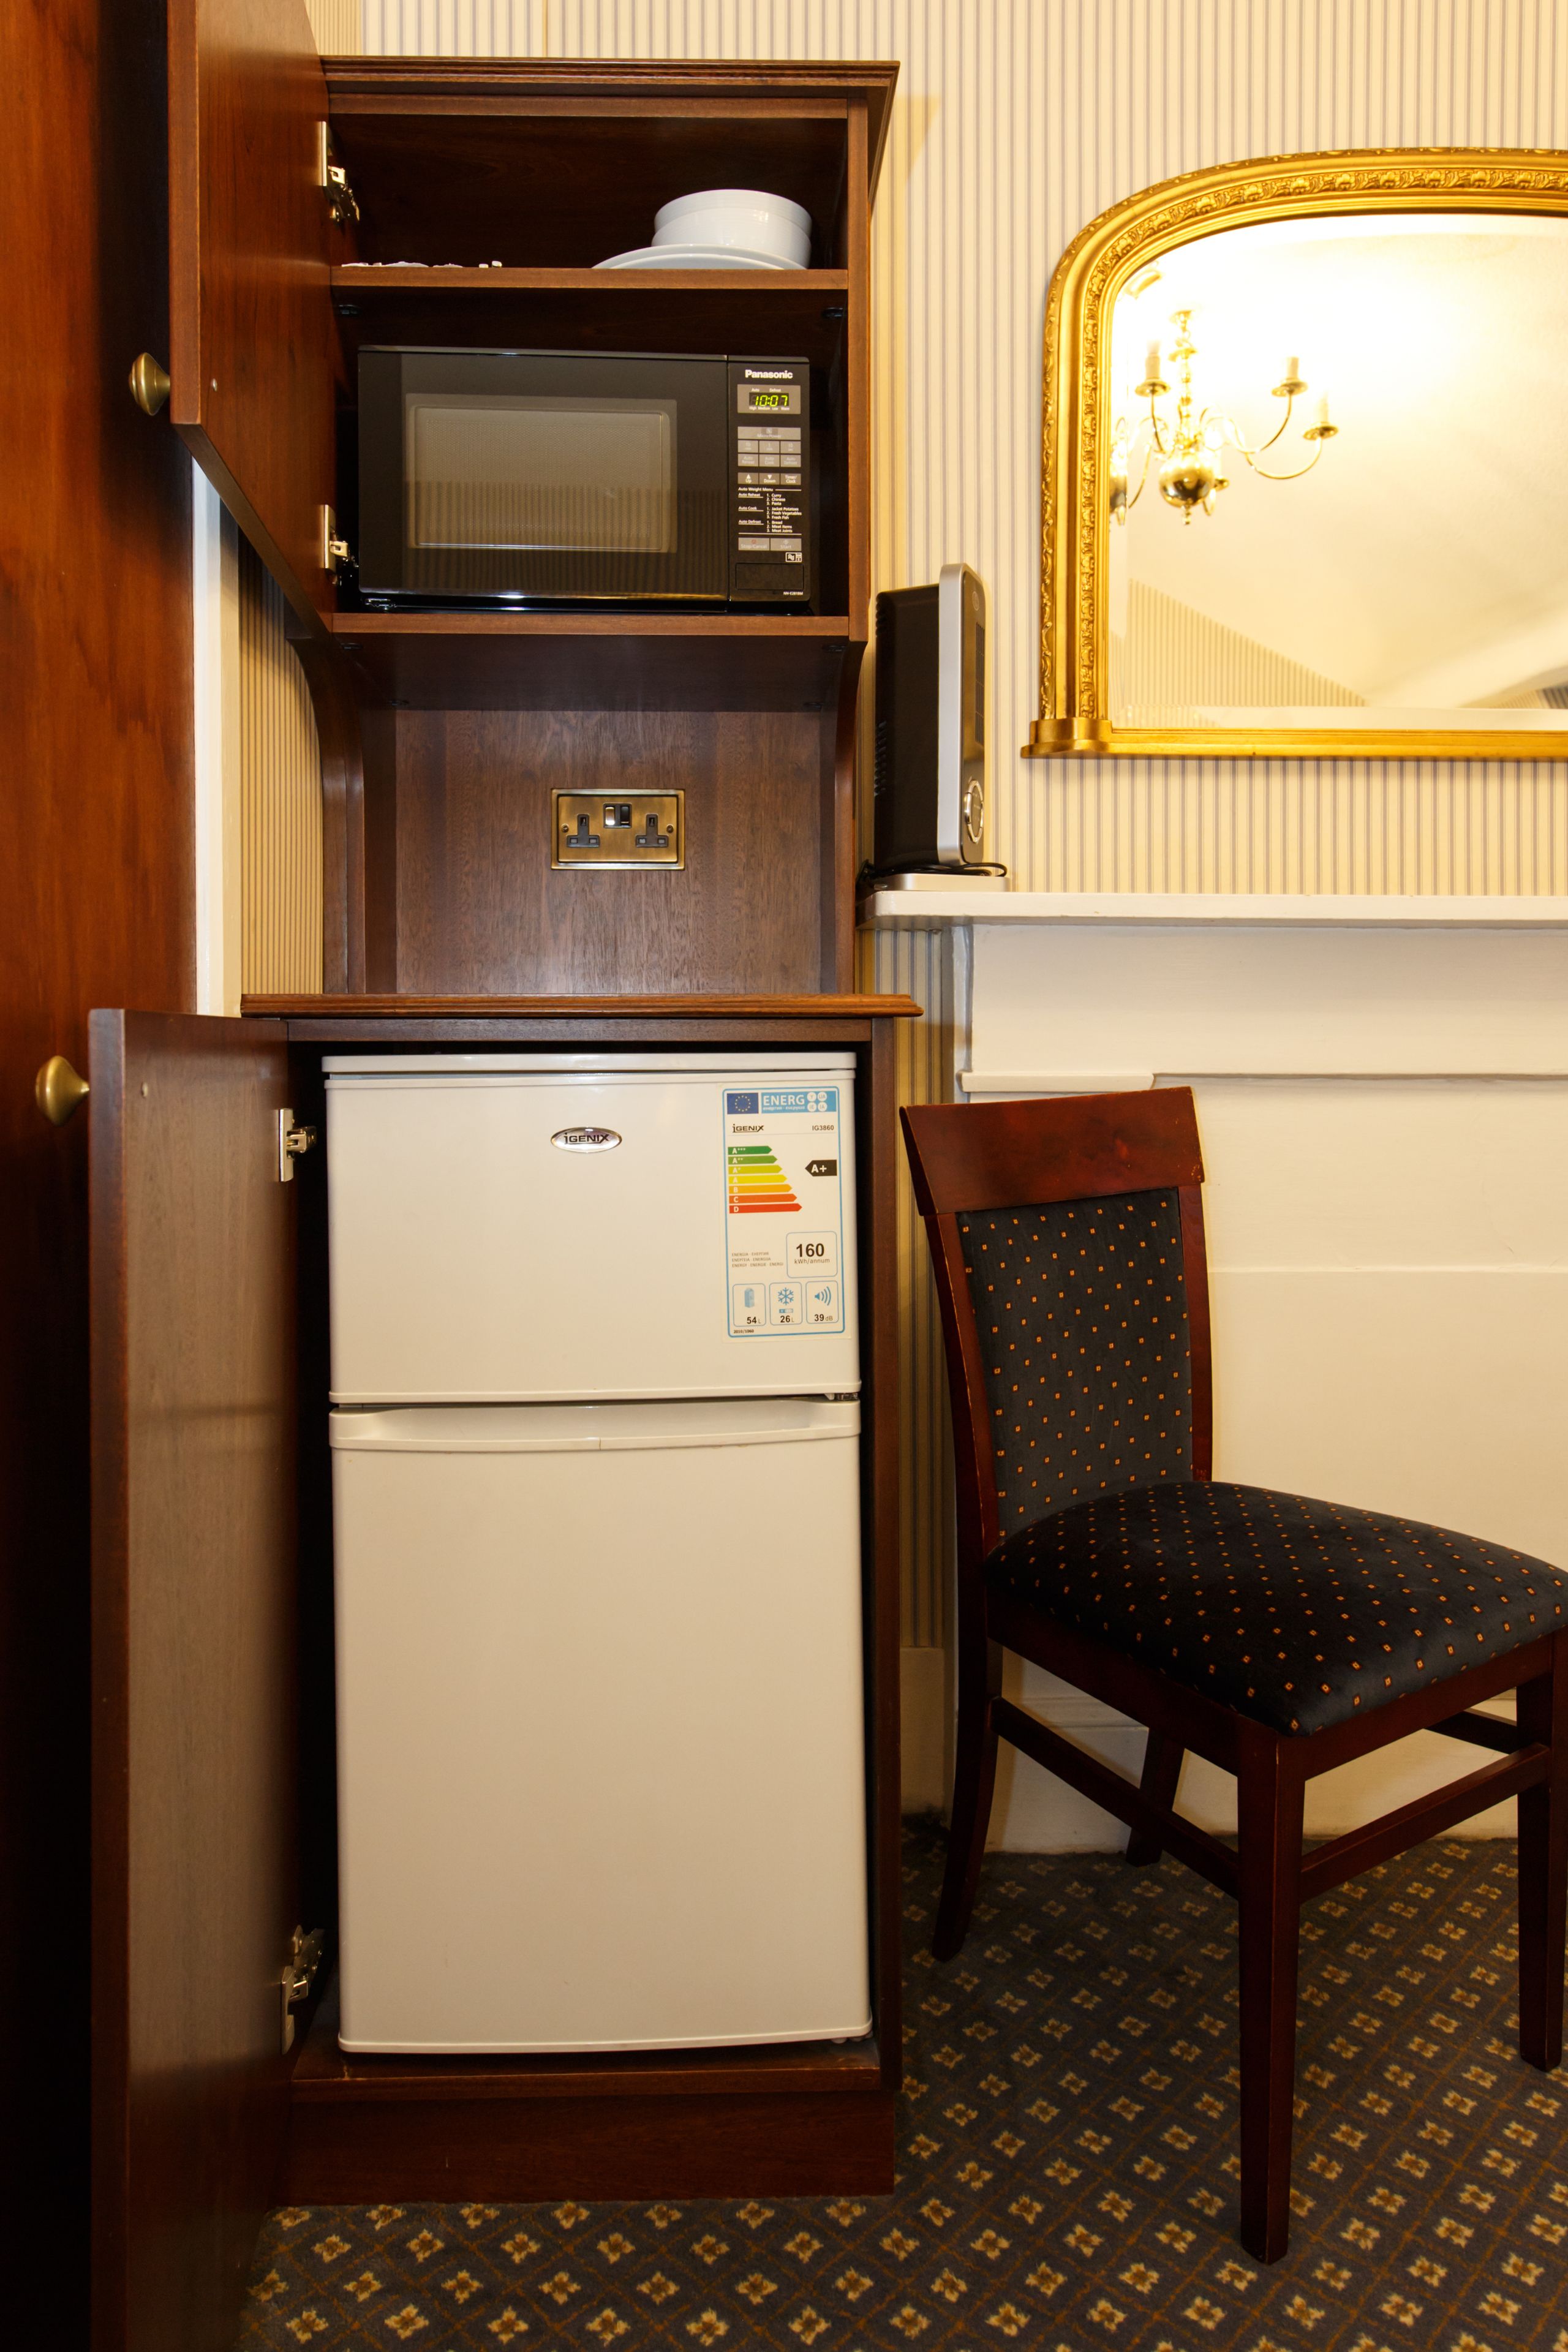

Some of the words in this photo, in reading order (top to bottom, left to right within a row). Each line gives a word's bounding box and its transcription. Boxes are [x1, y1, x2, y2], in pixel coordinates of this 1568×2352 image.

[745, 369, 793, 379] Panasonic
[755, 395, 788, 407] 10:07
[763, 1095, 805, 1106] ENERG
[812, 1164, 827, 1173] A+
[796, 1243, 824, 1257] 160
